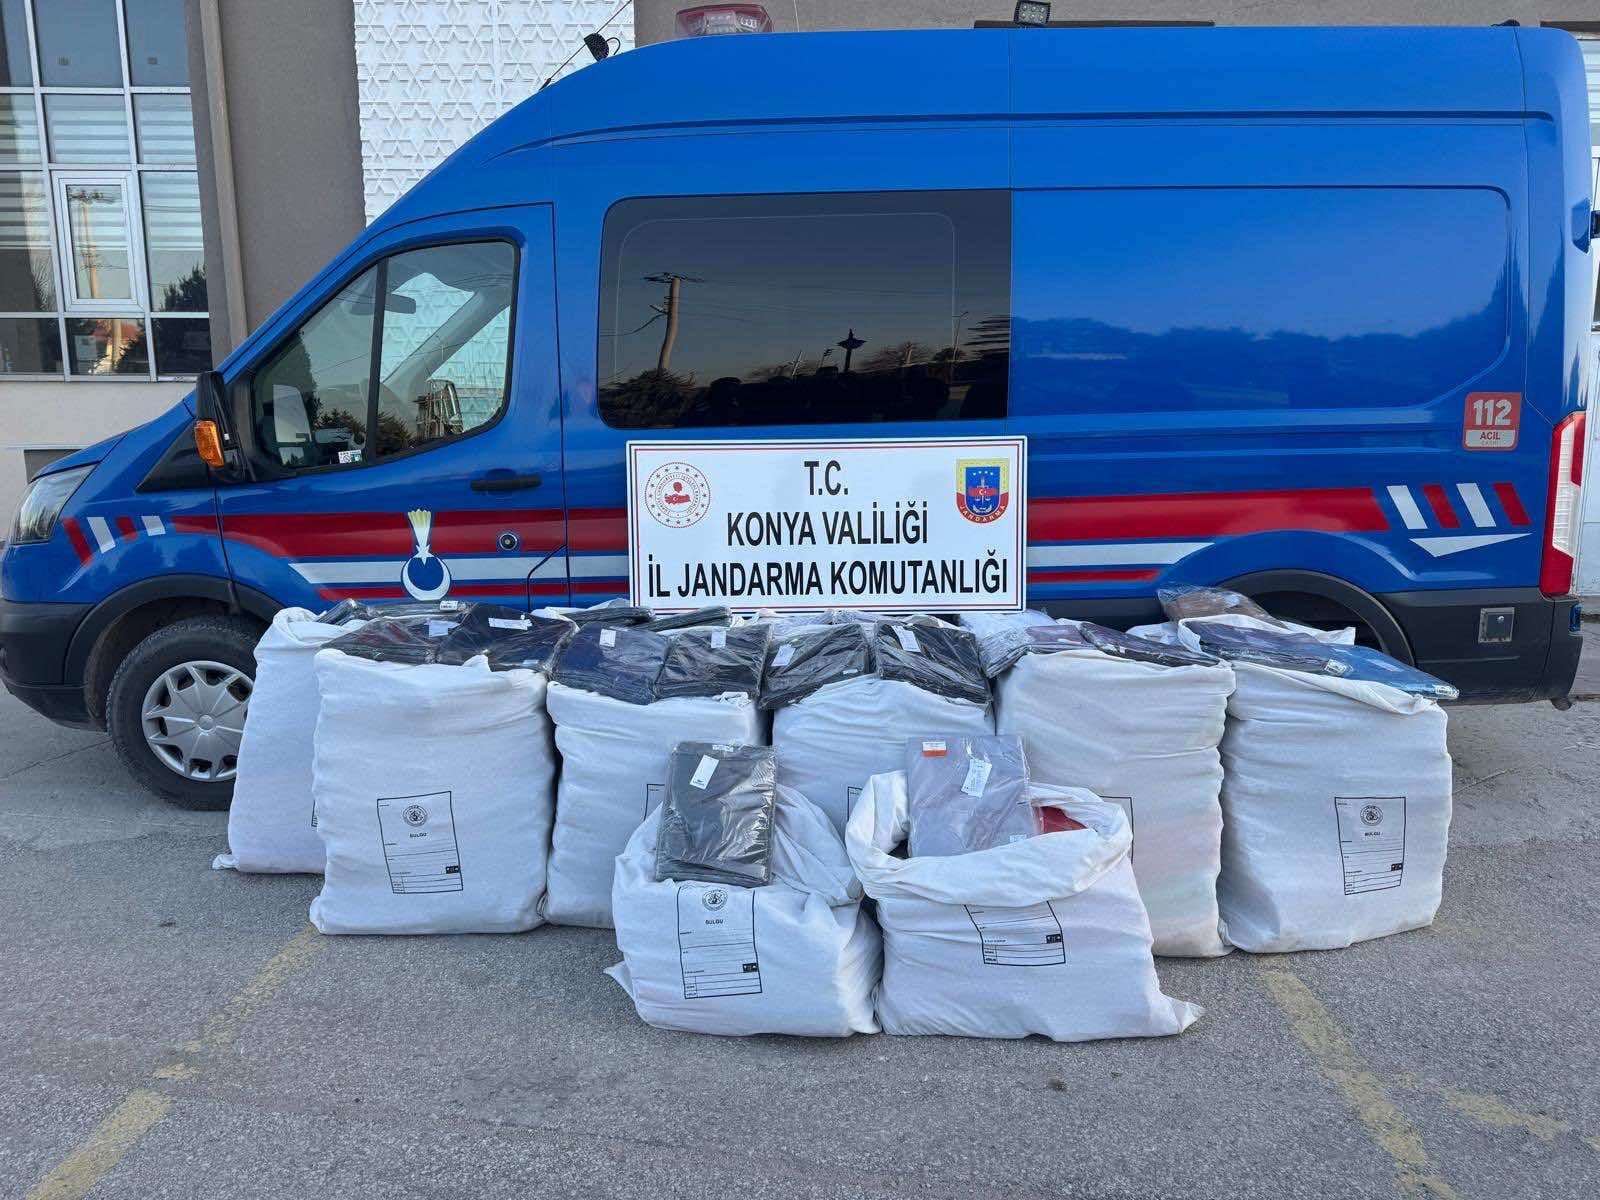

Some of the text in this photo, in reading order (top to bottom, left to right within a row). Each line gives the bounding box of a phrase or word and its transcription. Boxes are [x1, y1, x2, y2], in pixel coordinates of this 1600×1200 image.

[1473, 399, 1512, 426] 112
[804, 460, 849, 496] T.C.
[727, 500, 929, 547] KONYA VALİLİĞİ
[648, 549, 1008, 598] İL JANDARMA KOMUTANLIĞI
